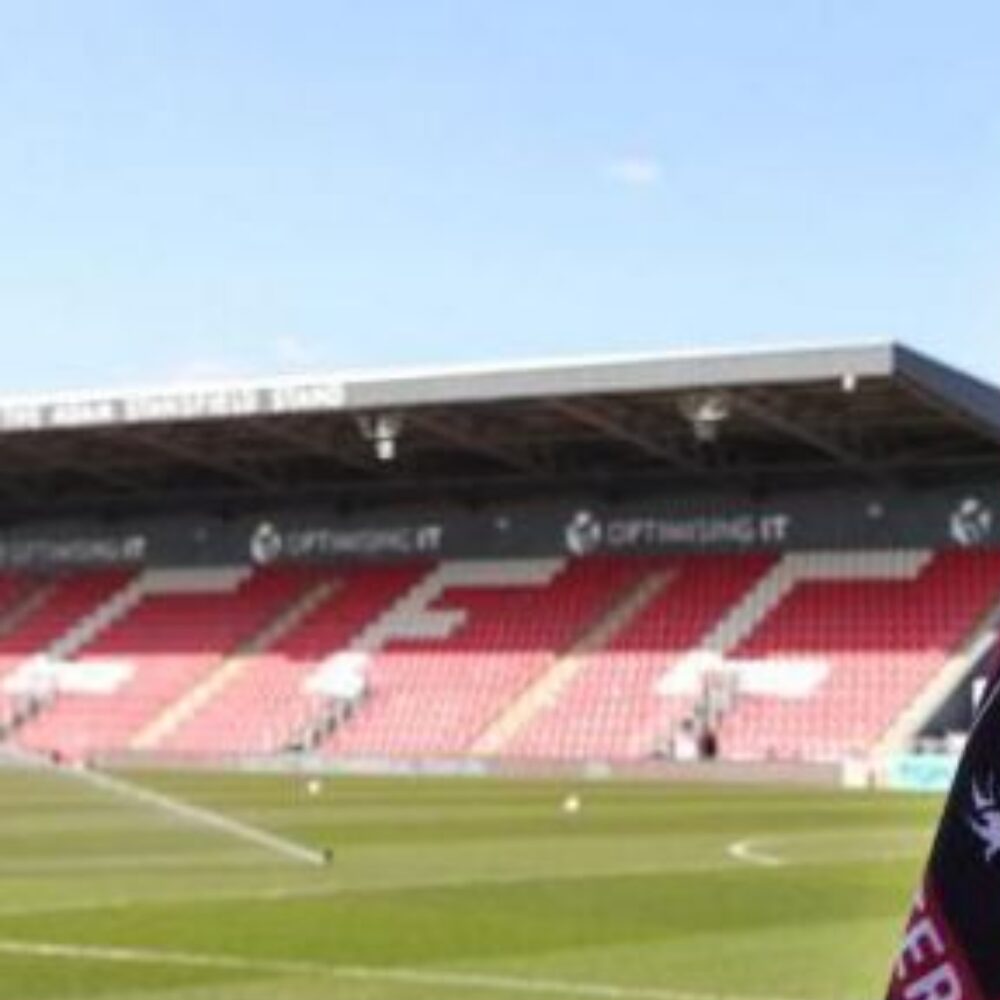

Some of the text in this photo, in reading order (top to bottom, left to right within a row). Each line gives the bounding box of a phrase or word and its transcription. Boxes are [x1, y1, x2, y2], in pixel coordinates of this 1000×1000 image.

[415, 525, 443, 550] IT
[760, 513, 791, 540] IT
[122, 534, 146, 558] IT
